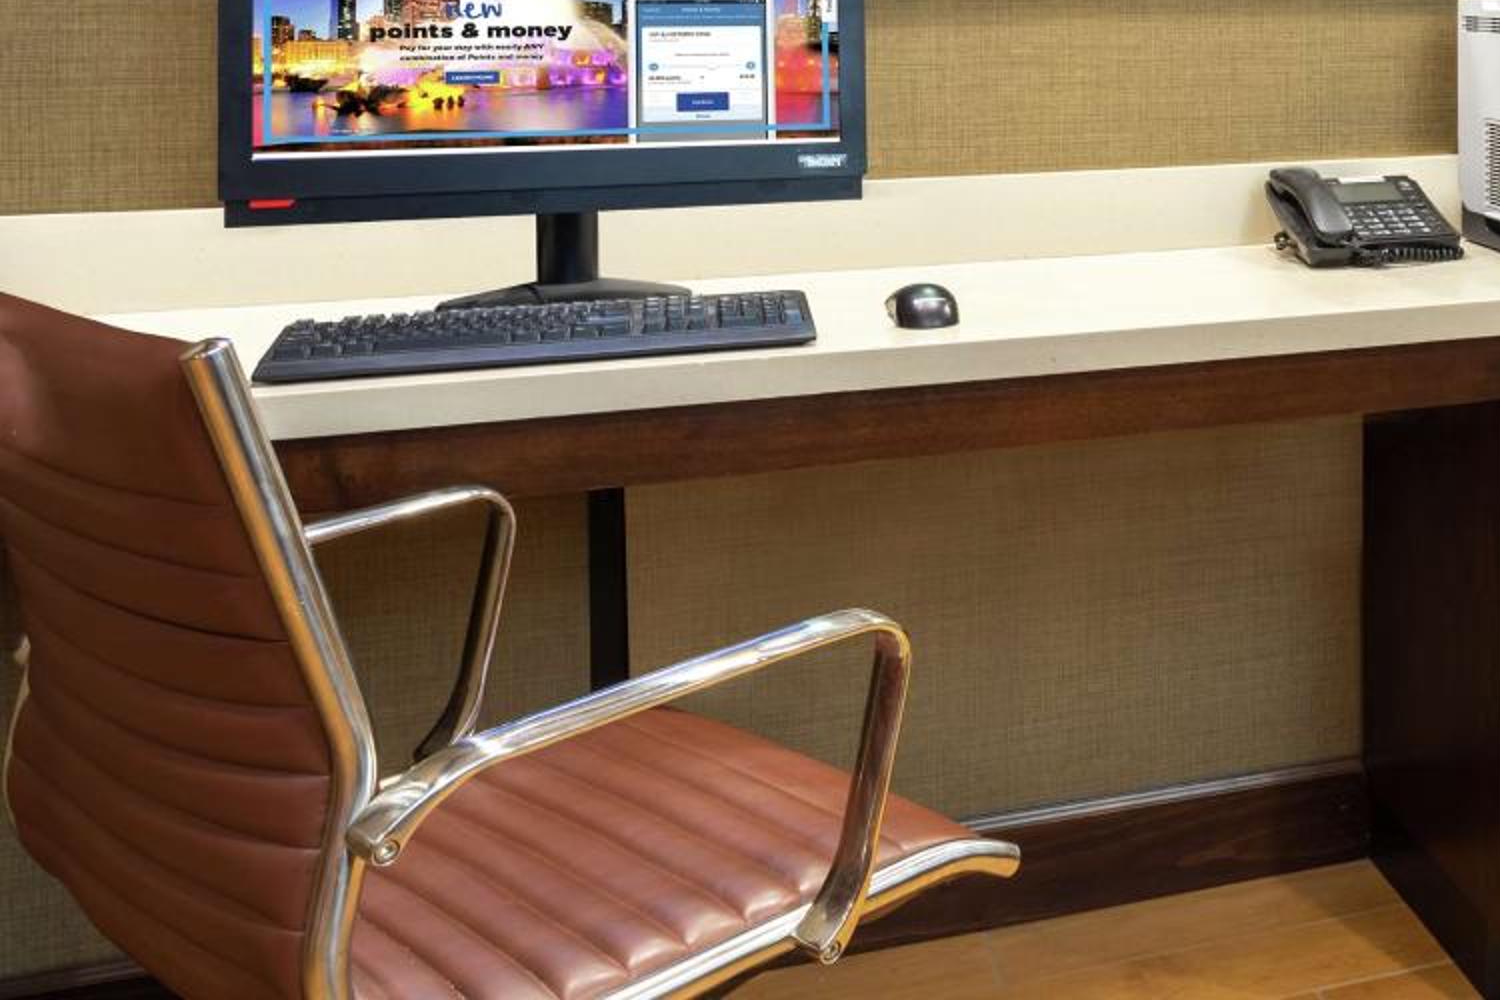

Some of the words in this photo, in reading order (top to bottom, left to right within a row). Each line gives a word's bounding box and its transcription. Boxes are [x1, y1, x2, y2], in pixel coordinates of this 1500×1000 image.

[445, 1, 503, 19] new
[369, 23, 453, 42] points
[461, 22, 479, 39] &
[487, 24, 573, 40] money
